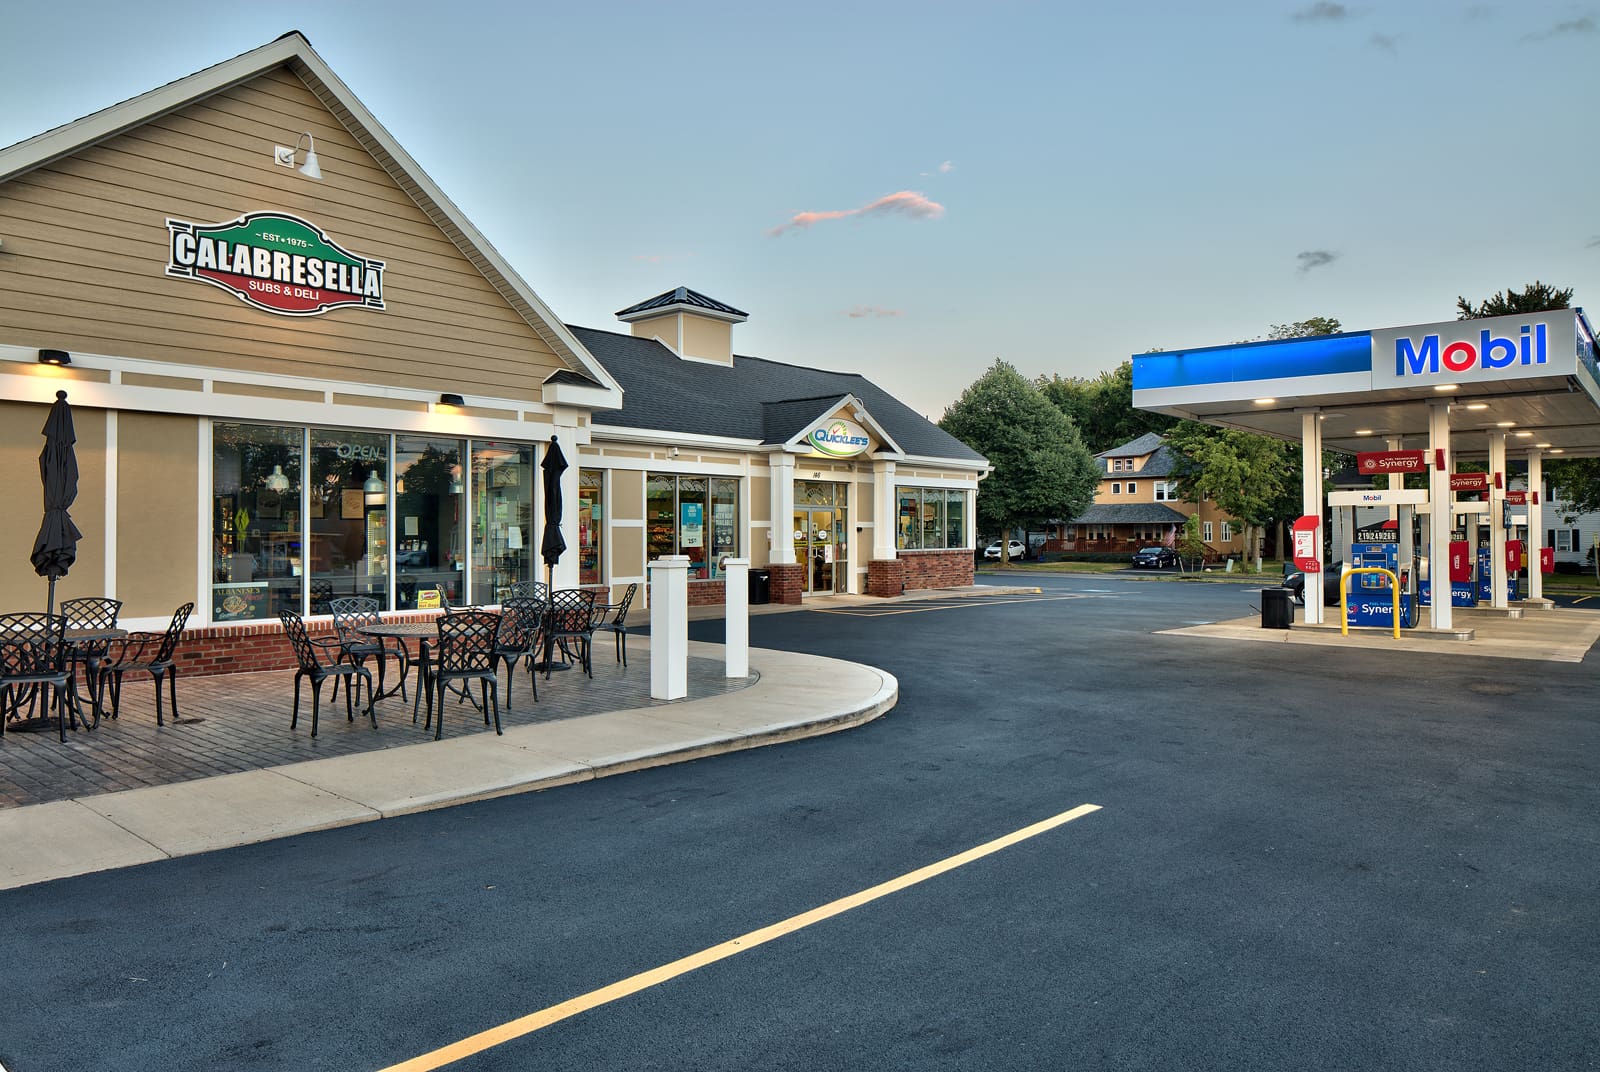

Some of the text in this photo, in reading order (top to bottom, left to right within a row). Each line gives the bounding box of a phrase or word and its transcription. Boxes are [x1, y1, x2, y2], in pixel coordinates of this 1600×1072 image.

[174, 232, 381, 298] CALABRESELLA
[248, 280, 319, 300] SUBS & DELI
[1395, 323, 1547, 376] Mobil
[336, 443, 381, 459] OPEN
[1378, 459, 1418, 469] Synergy
[1451, 479, 1482, 487] Synergy
[1452, 590, 1472, 599] ergy
[1361, 603, 1407, 617] Synery
